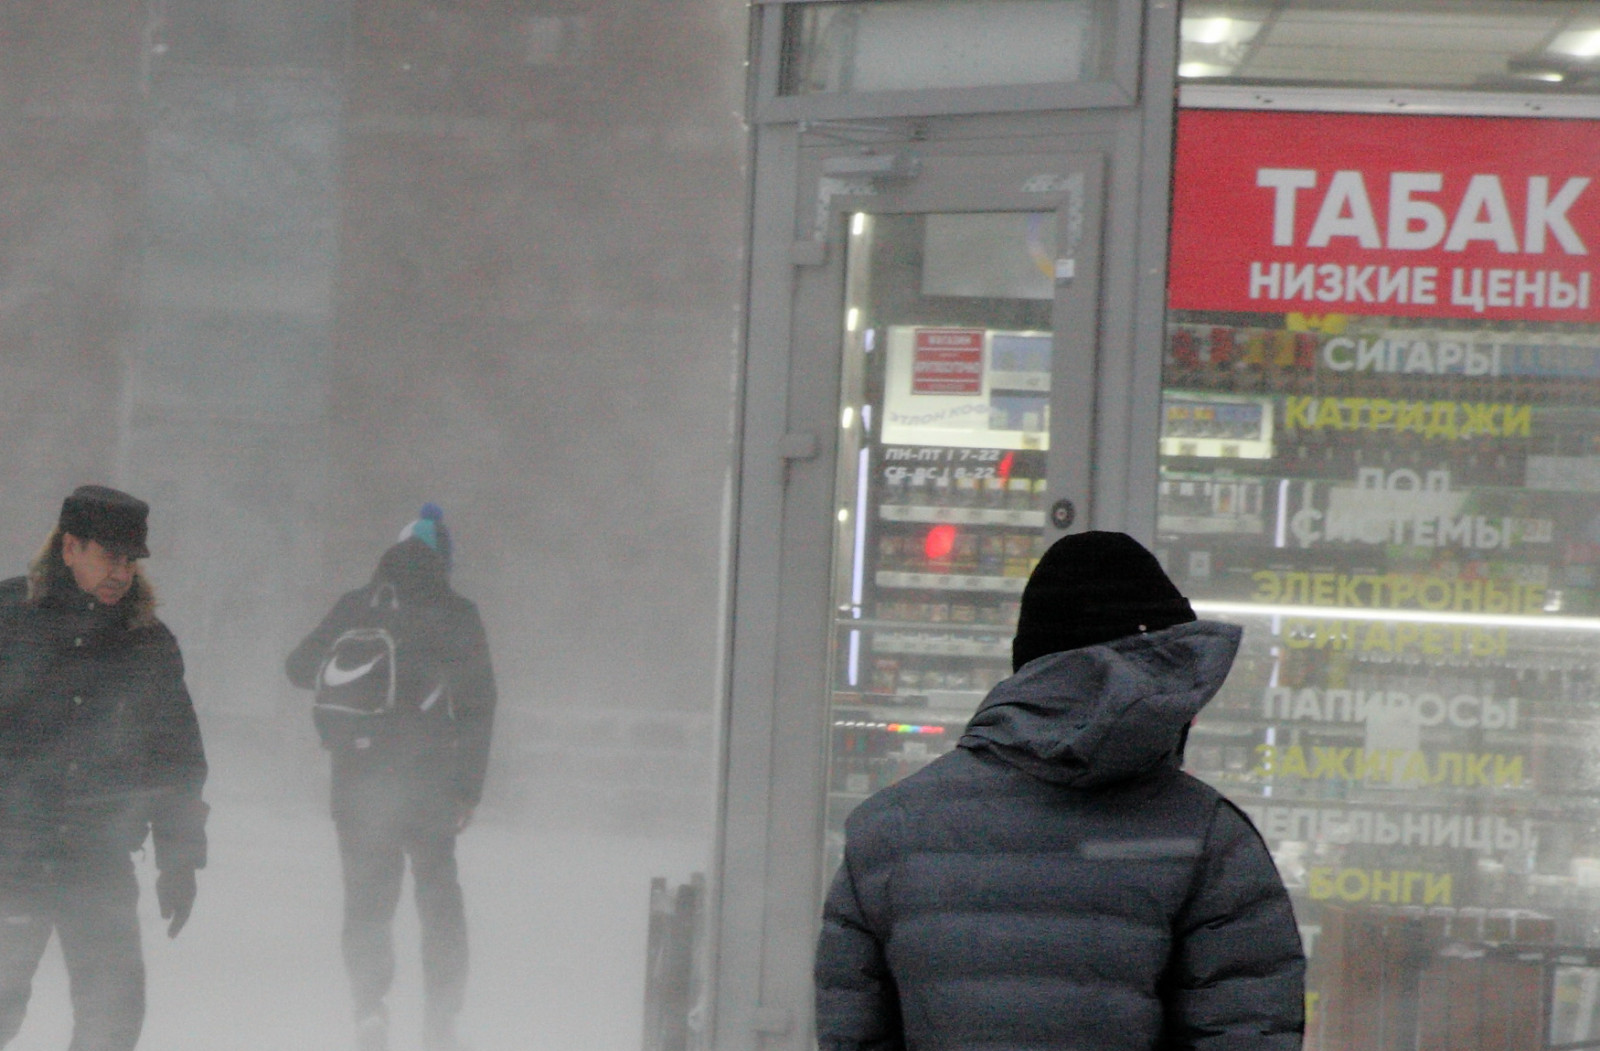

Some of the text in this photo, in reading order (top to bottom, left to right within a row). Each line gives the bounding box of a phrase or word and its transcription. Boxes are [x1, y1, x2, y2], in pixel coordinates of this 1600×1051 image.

[1255, 167, 1592, 256] ТАБАК
[1248, 261, 1591, 312] НИЗКИЕ ЦЕНЫ
[1323, 337, 1500, 376] СИГАРЫ
[1284, 396, 1532, 439] КАТРИДЖИ
[885, 447, 1000, 462] ПН-ПТ 7-22
[1290, 507, 1512, 550] СИСТЕМЫ
[1251, 570, 1547, 615] ЭЛЕКТРОНЫЕ
[1281, 616, 1509, 657] СИГАРЕТЫ
[1261, 686, 1519, 730] ПАПИРОСЫ
[1253, 743, 1524, 786] ЗАЖИГАЛКИ
[1308, 866, 1454, 905] БОНГИ
